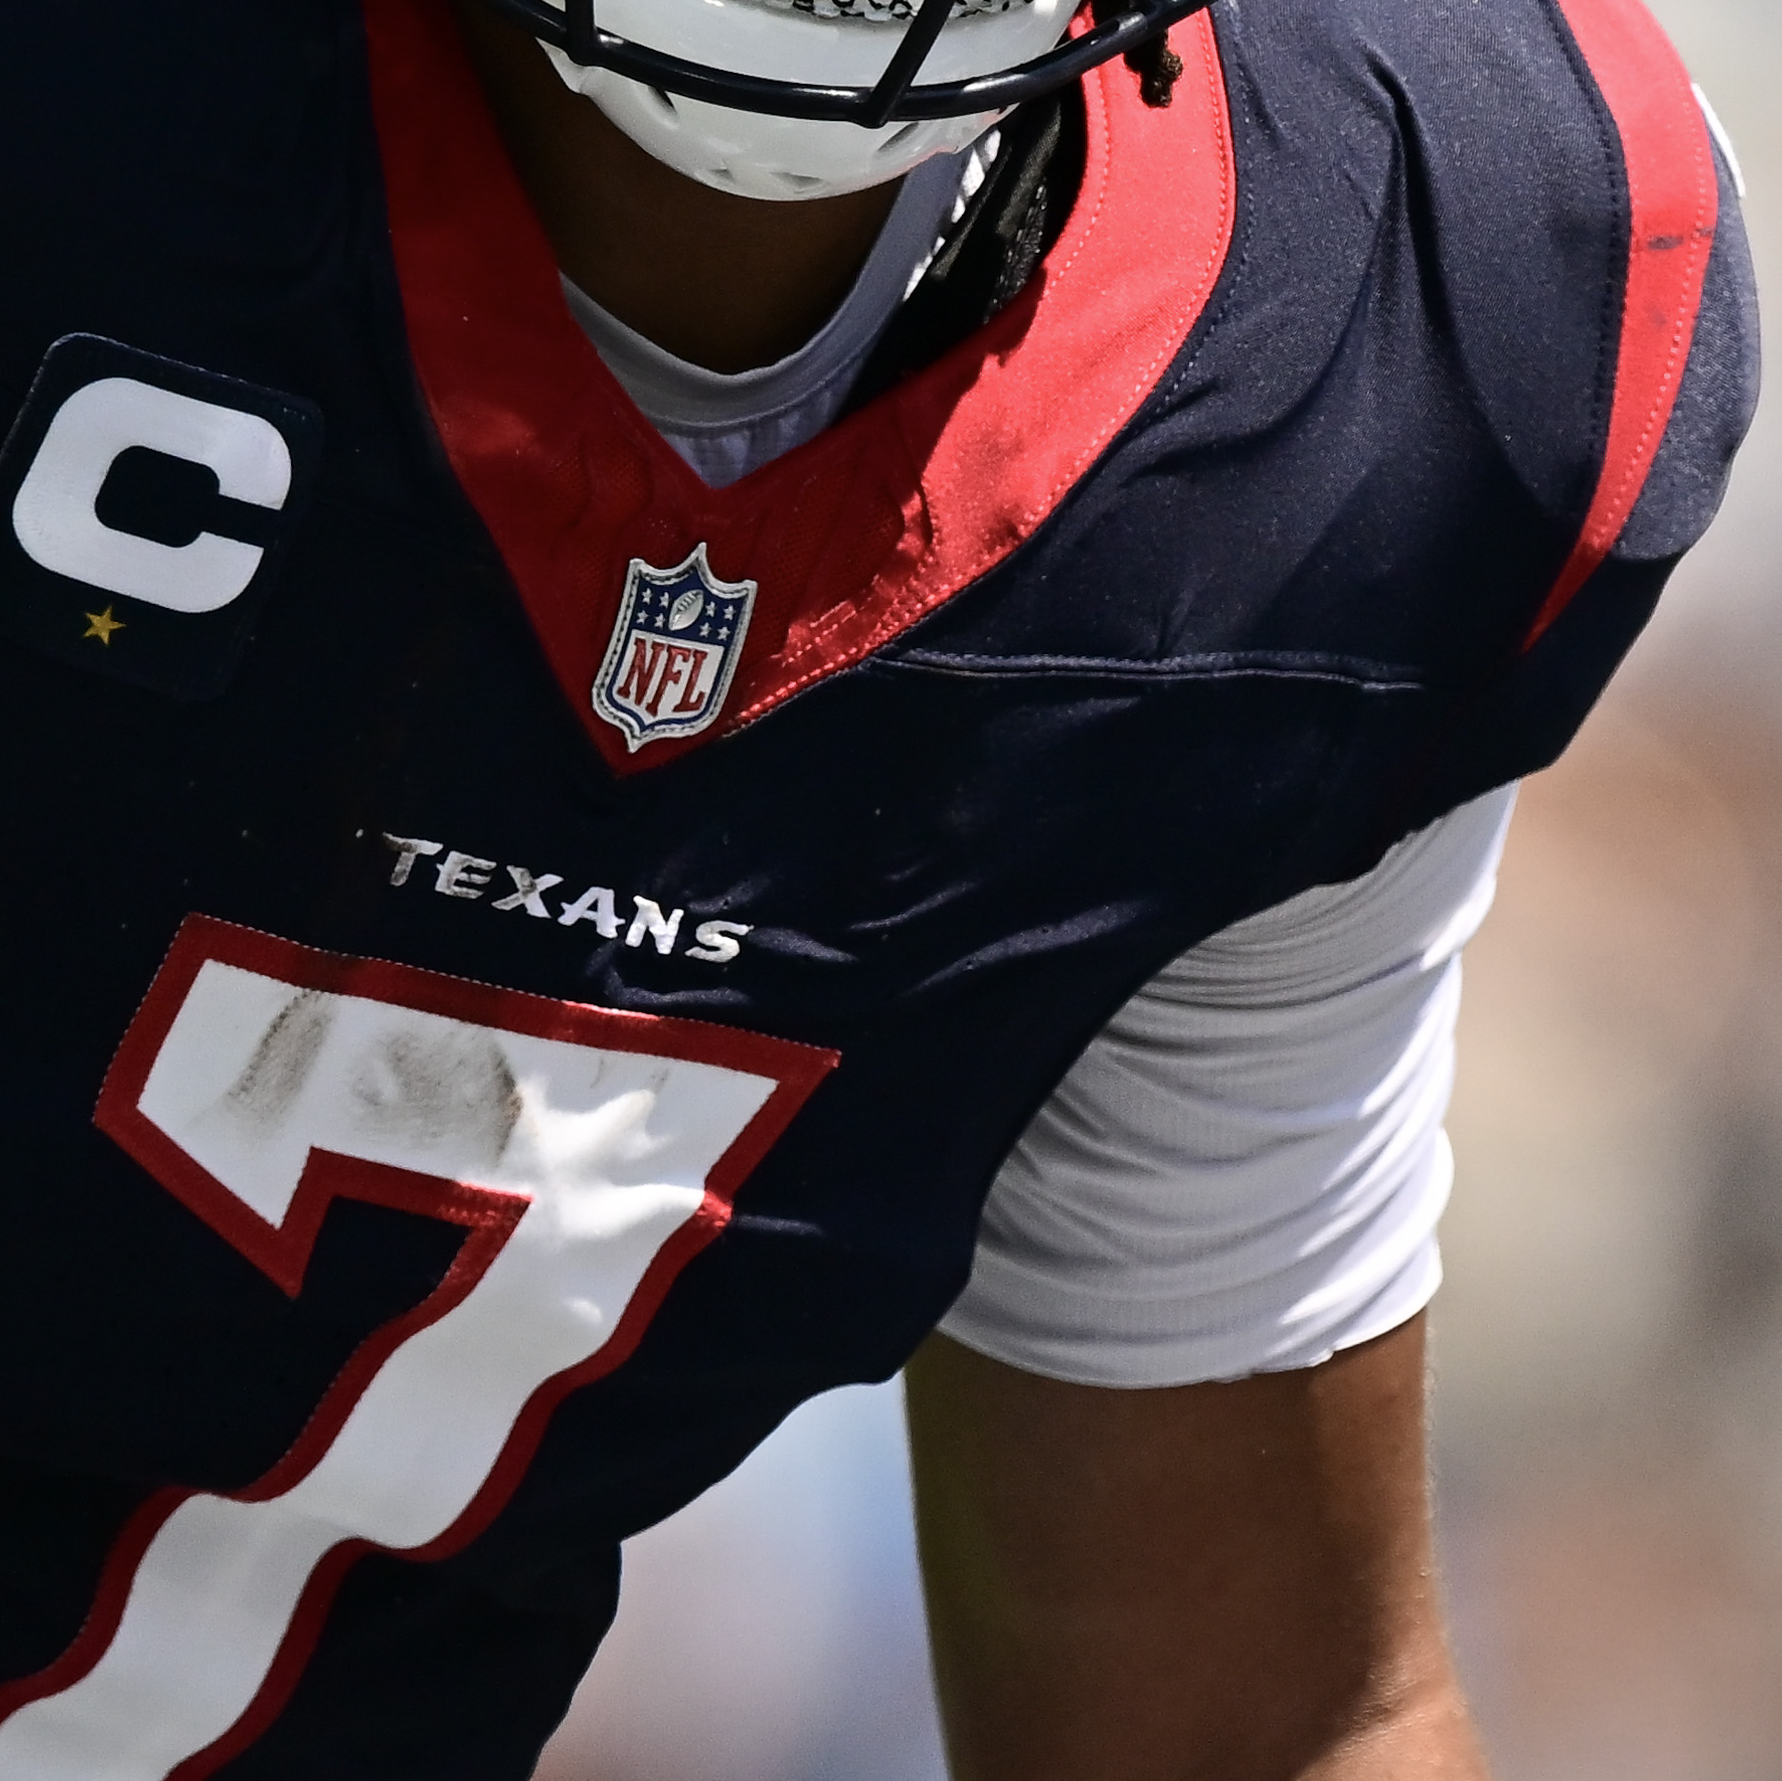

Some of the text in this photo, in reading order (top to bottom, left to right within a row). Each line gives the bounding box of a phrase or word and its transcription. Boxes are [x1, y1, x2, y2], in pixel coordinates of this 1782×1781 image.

[12, 377, 292, 613] C
[616, 637, 710, 717] NFL
[382, 830, 755, 963] TEXANS
